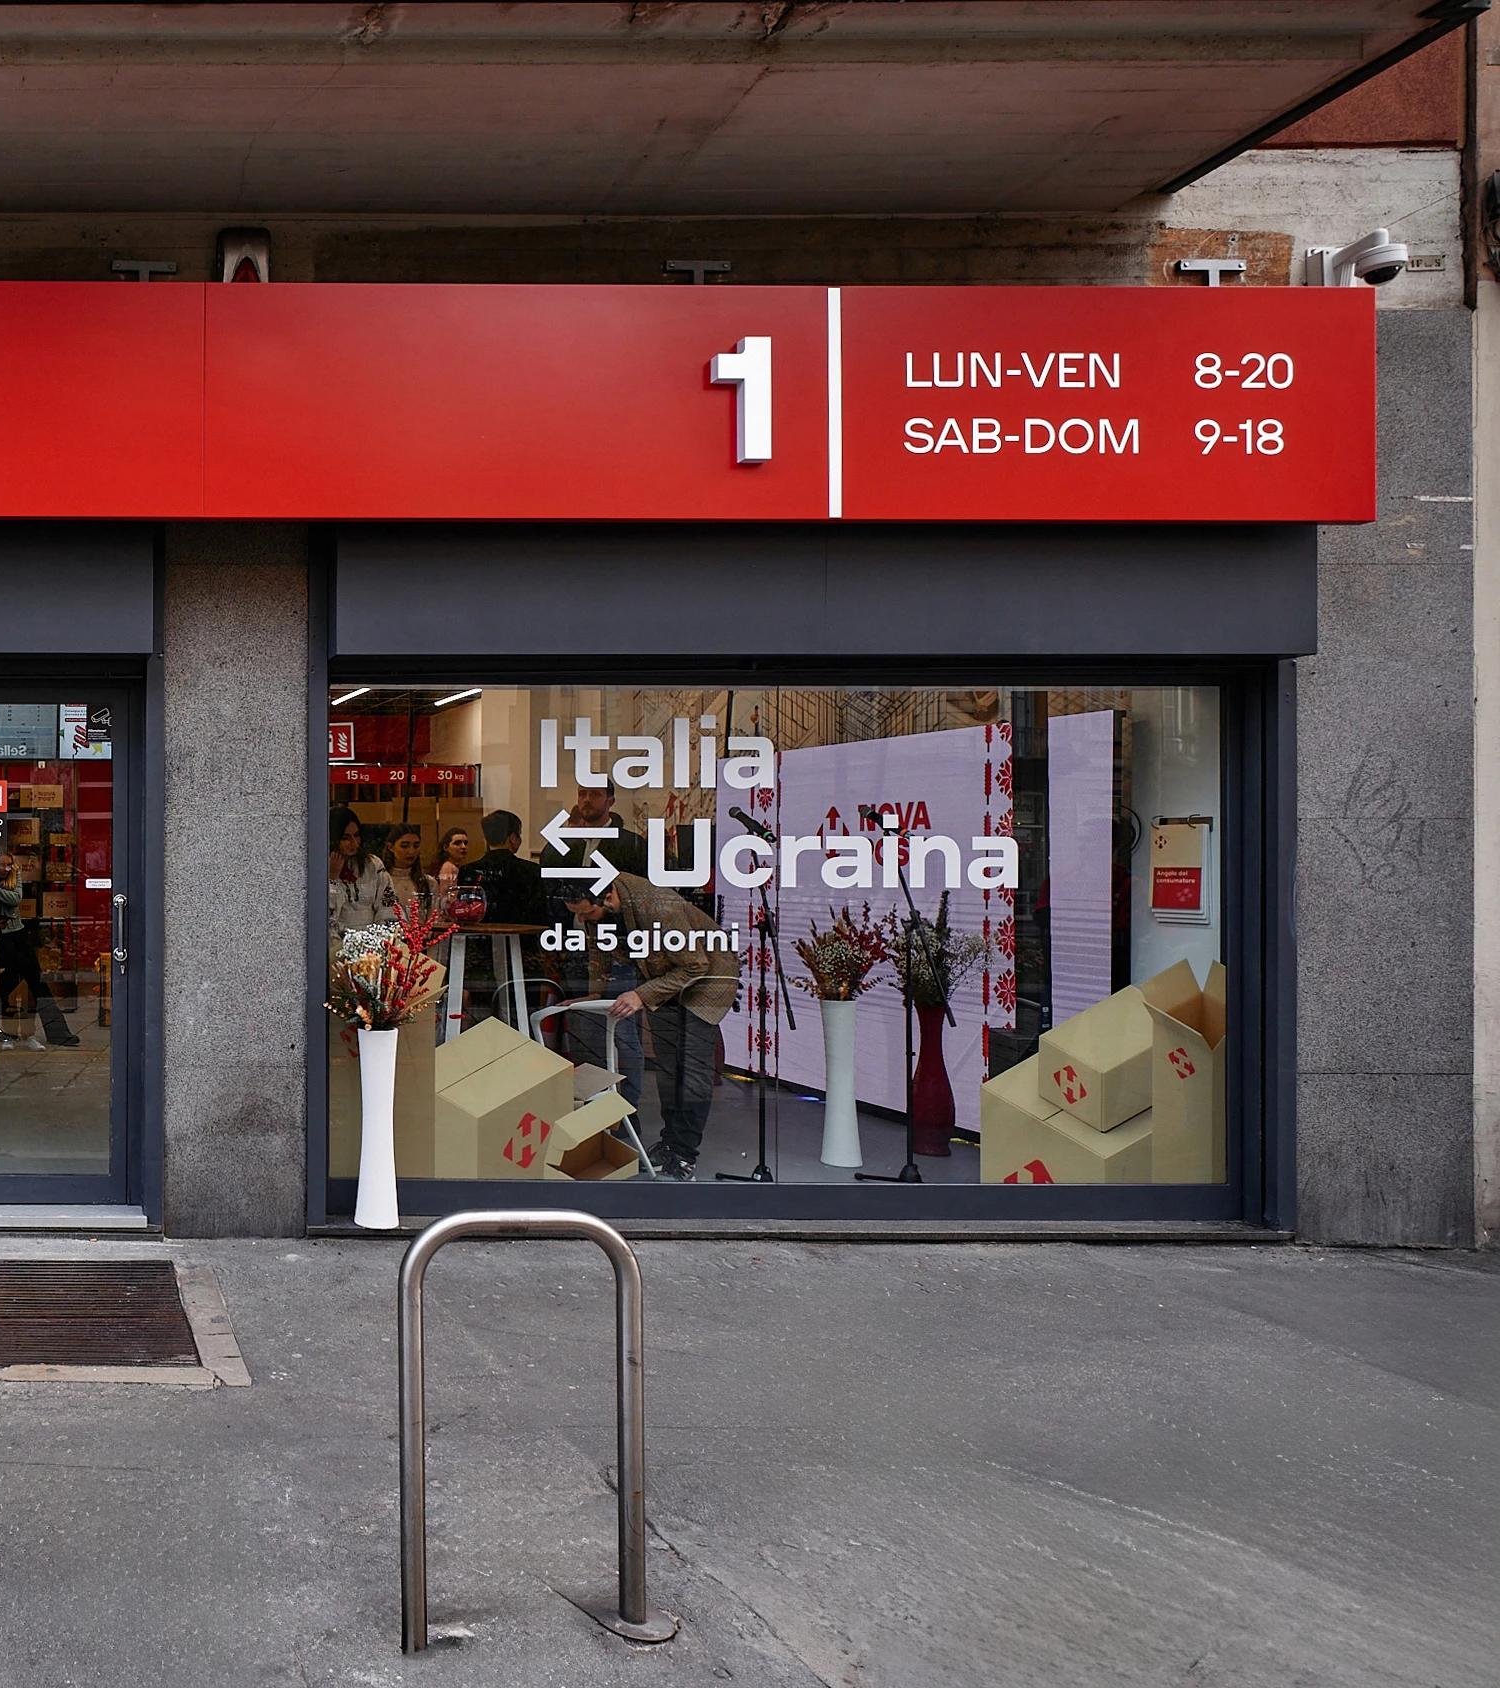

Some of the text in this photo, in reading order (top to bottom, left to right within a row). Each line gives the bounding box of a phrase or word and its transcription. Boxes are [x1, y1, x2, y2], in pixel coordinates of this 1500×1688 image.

[904, 352, 1295, 390] LUN-VEN 8-20
[710, 336, 773, 465] 1
[902, 417, 1286, 455] SAB-DOM 9-18
[540, 714, 775, 790] Italia
[345, 770, 370, 782] 15 kg
[389, 770, 405, 780] 20
[437, 770, 464, 781] 30 kg
[647, 814, 1019, 890] Ucraina
[540, 922, 739, 958] da 5 giorni
